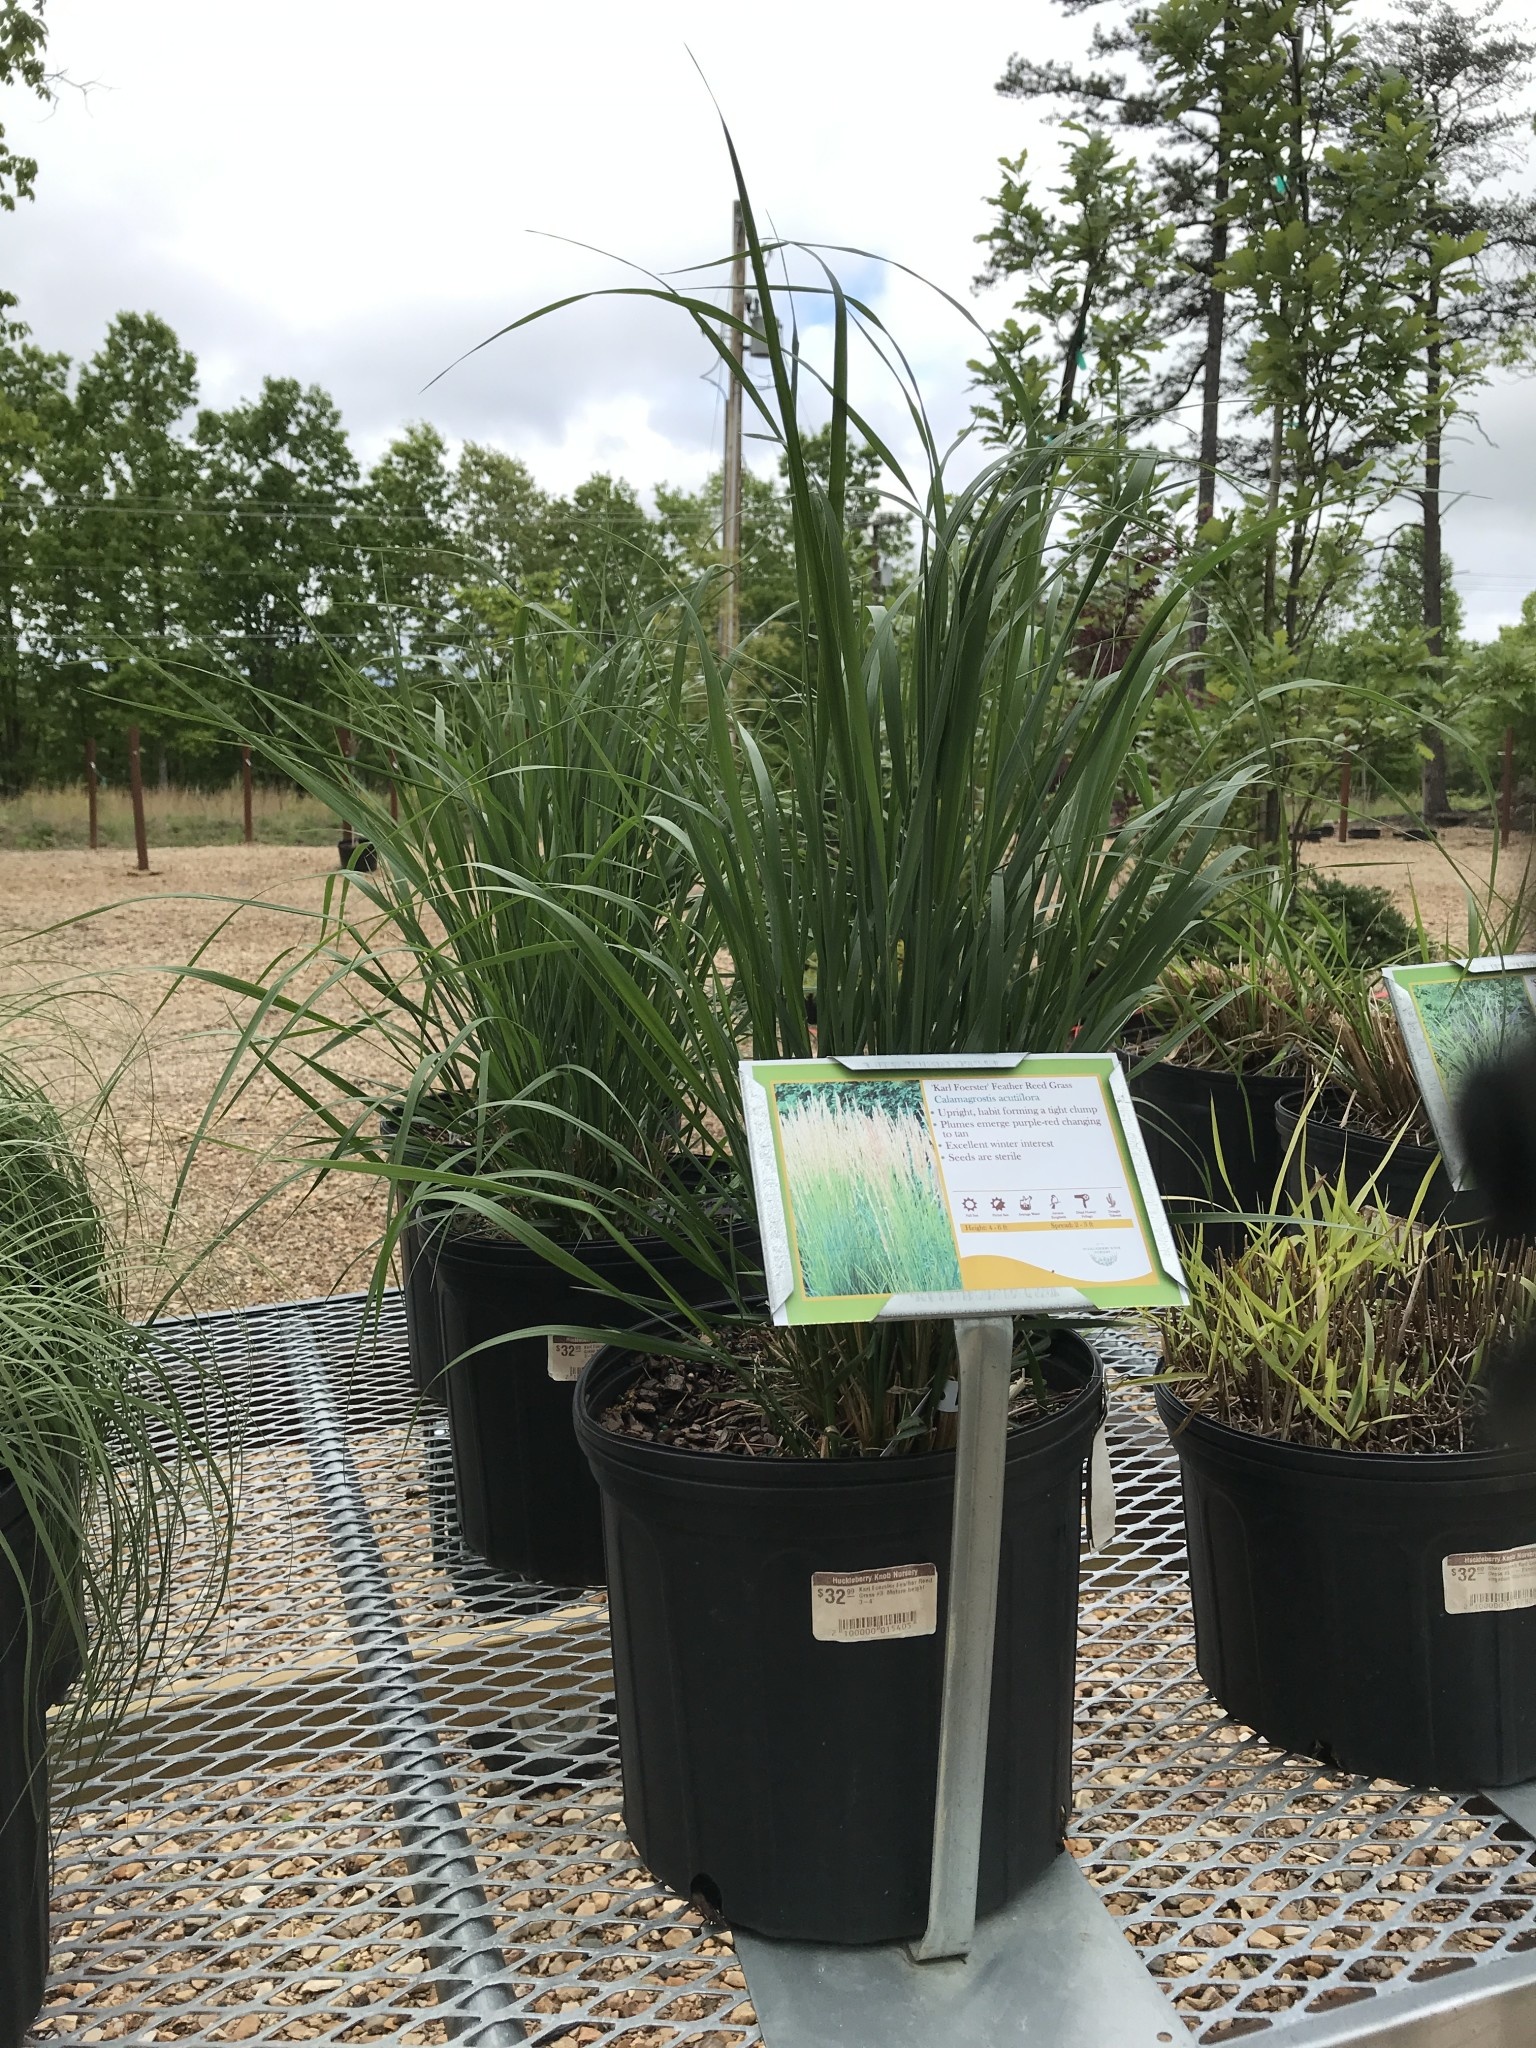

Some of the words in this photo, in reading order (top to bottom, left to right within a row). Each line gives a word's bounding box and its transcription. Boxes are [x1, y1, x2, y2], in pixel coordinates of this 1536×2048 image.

[991, 1082, 1023, 1090] Feather
[1025, 1081, 1047, 1090] Reed
[1048, 1081, 1073, 1089] Grass
[934, 1094, 997, 1104] Calamagrostis
[998, 1093, 1041, 1102] acutiflora
[938, 1108, 976, 1118] Upright,
[977, 1107, 1001, 1116] habit
[1002, 1106, 1039, 1116] forming
[1048, 1105, 1068, 1115] tight
[1069, 1104, 1098, 1115] clump
[940, 1120, 975, 1129] Plumes
[976, 1120, 1010, 1128] emerge
[1012, 1118, 1060, 1128] purple-red
[1061, 1117, 1102, 1127] changing
[945, 1140, 989, 1150] Excellent
[990, 1140, 1018, 1148] winter
[1020, 1139, 1055, 1148] interest
[948, 1152, 976, 1162] Seeds
[994, 1151, 1022, 1161] sterile
[832, 1575, 873, 1585] Huckleberry
[874, 1572, 891, 1581] Knob
